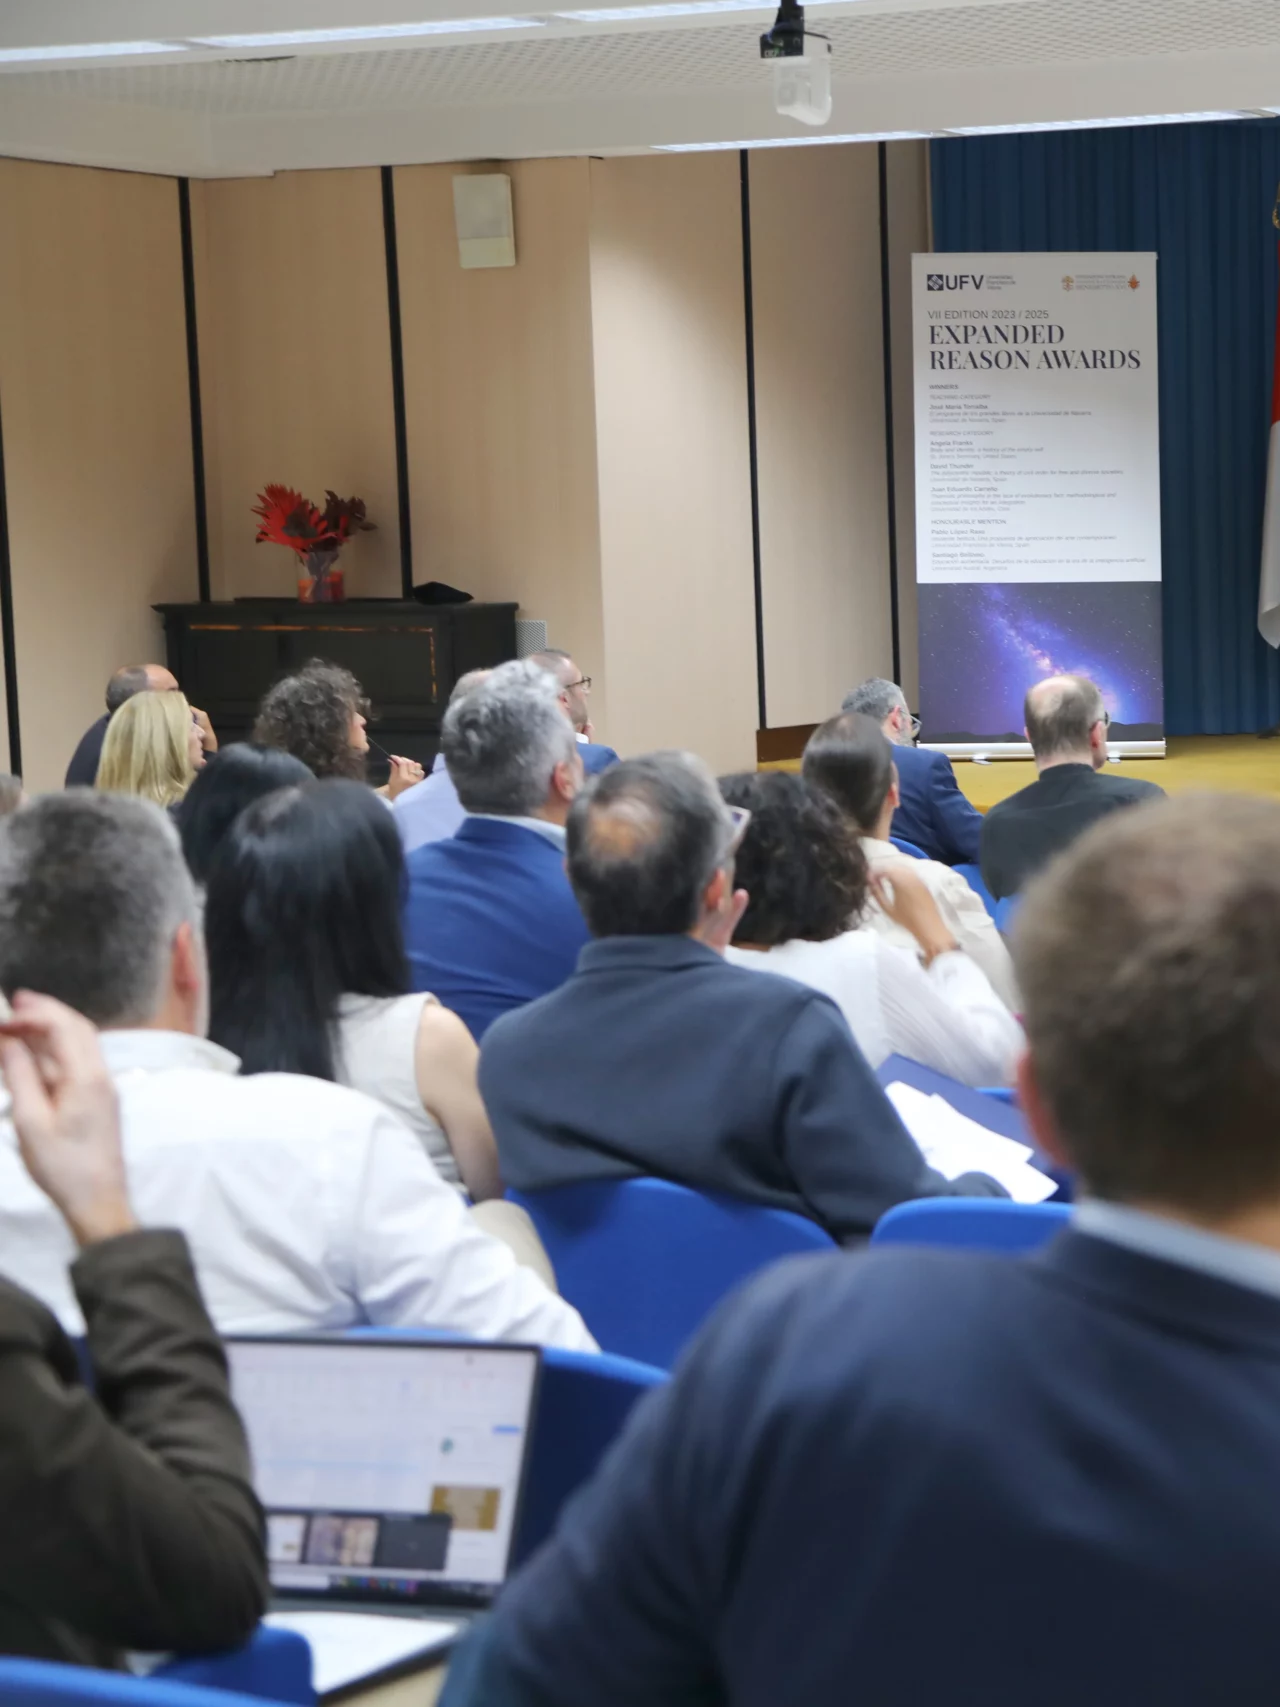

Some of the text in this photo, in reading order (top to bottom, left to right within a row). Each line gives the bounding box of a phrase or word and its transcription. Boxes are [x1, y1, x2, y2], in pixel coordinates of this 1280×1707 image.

[946, 275, 984, 290] UFV
[928, 310, 1049, 319] VII EDITION 2023 / 2025
[929, 325, 1064, 344] EXPANDED
[930, 350, 1141, 370] REASON AWARDS
